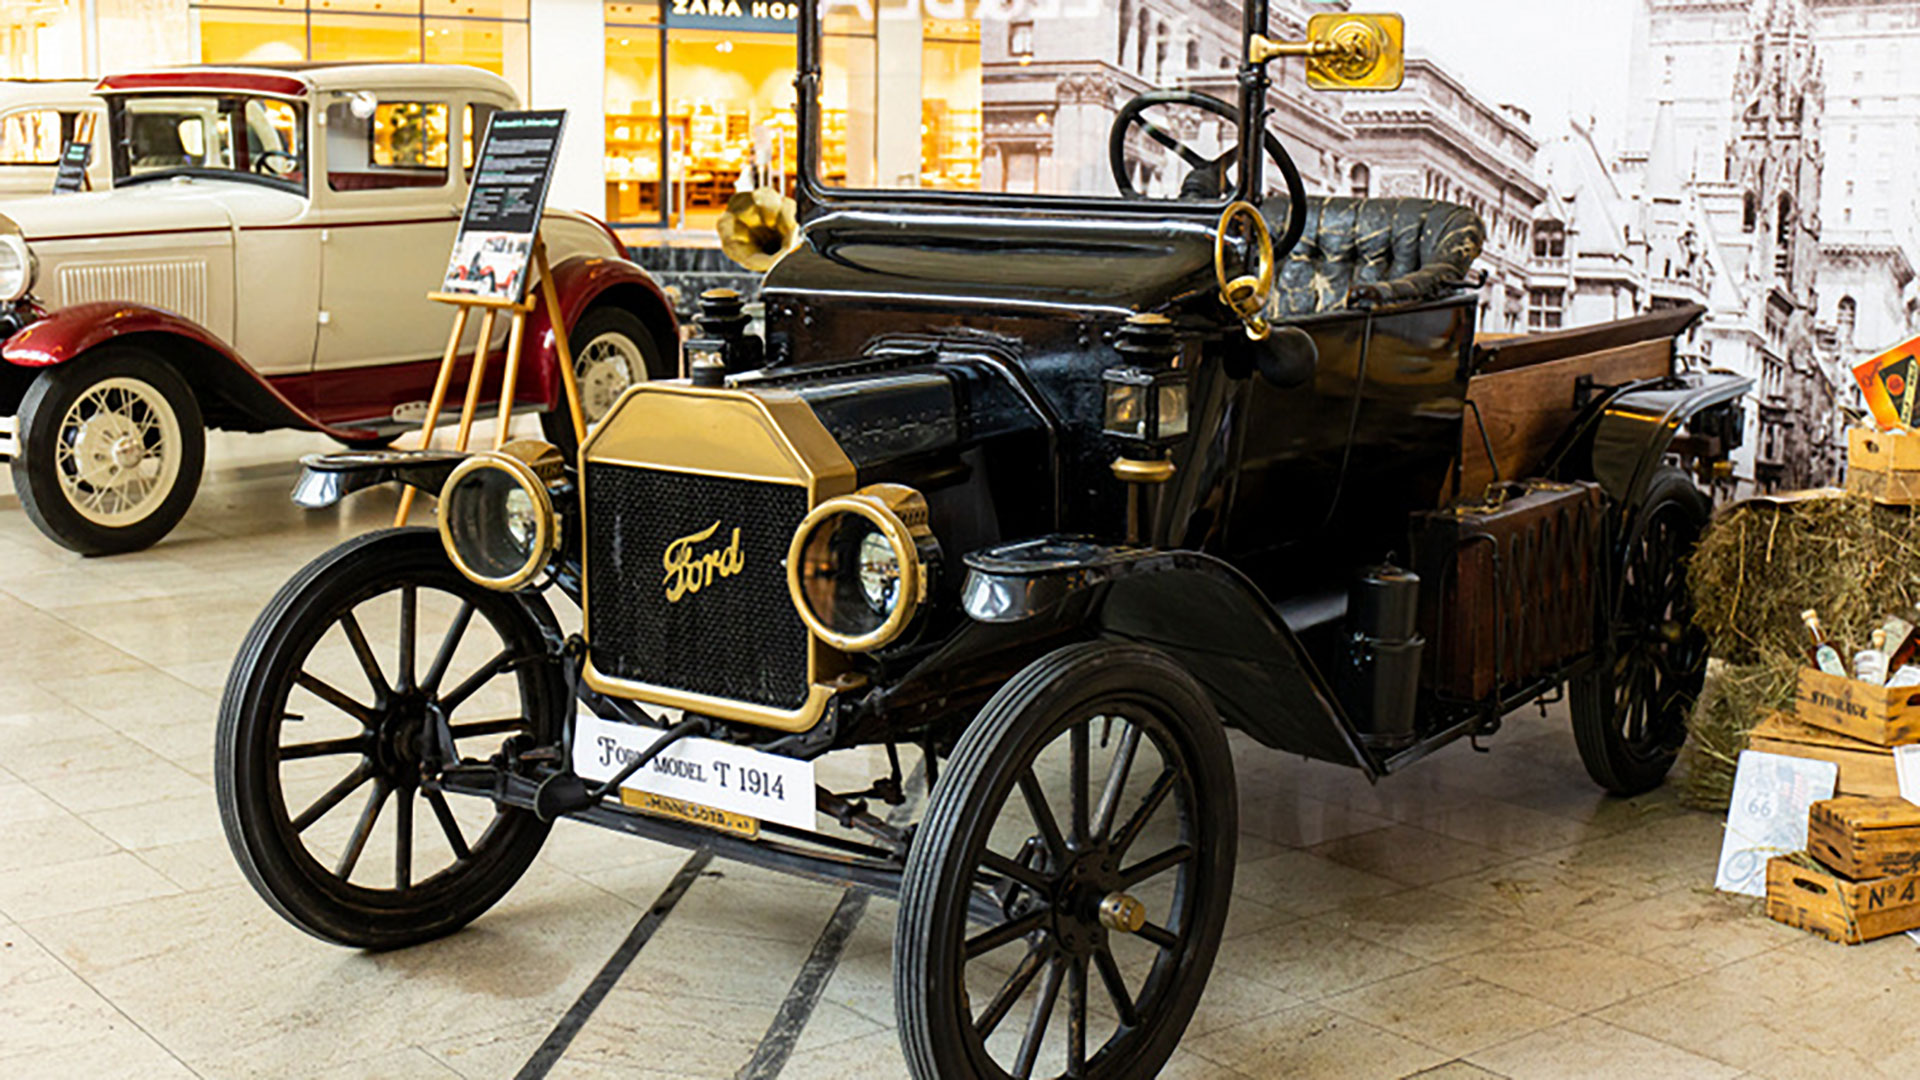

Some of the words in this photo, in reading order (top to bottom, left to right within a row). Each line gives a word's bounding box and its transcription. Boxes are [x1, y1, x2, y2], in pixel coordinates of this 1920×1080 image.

[672, 0, 742, 16] ZARA
[662, 519, 744, 602] Ford
[712, 760, 731, 788] T
[738, 767, 785, 801] 1914
[1748, 798, 1772, 818] 66
[1899, 880, 1915, 902] 4
